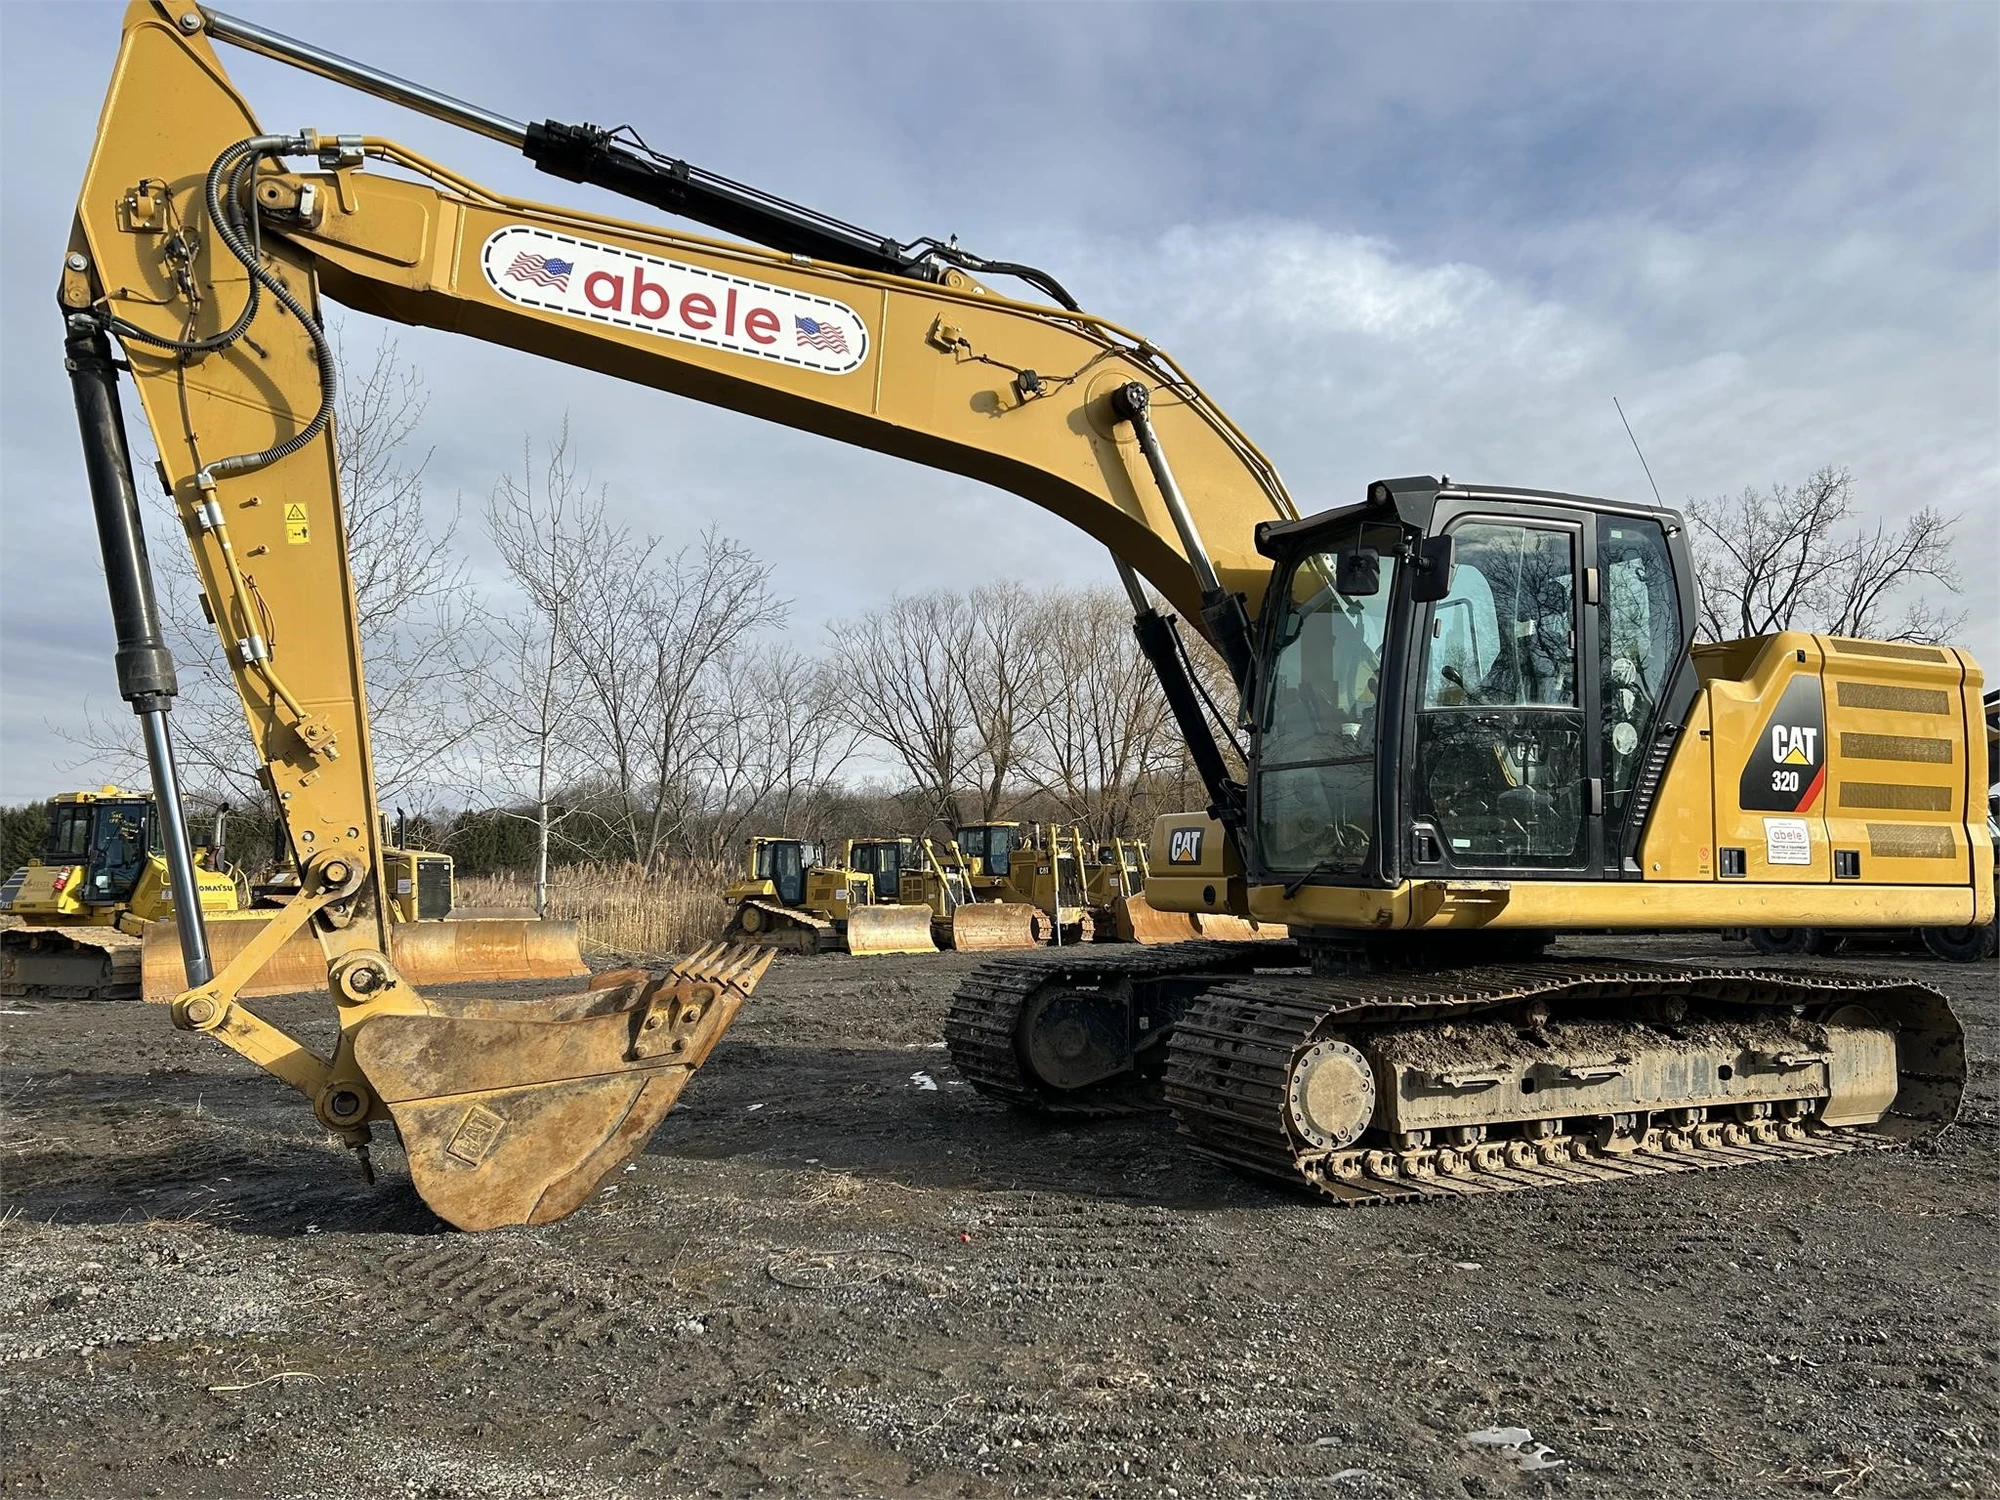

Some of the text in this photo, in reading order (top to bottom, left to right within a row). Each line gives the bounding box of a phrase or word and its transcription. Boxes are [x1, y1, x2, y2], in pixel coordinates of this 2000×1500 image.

[584, 266, 781, 345] abele
[1771, 724, 1817, 766] CAT
[1771, 770, 1799, 792] 320
[1171, 831, 1201, 861] CAT
[1773, 829, 1803, 840] abele
[198, 884, 233, 892] OMATSU
[453, 1113, 496, 1160] CAT
